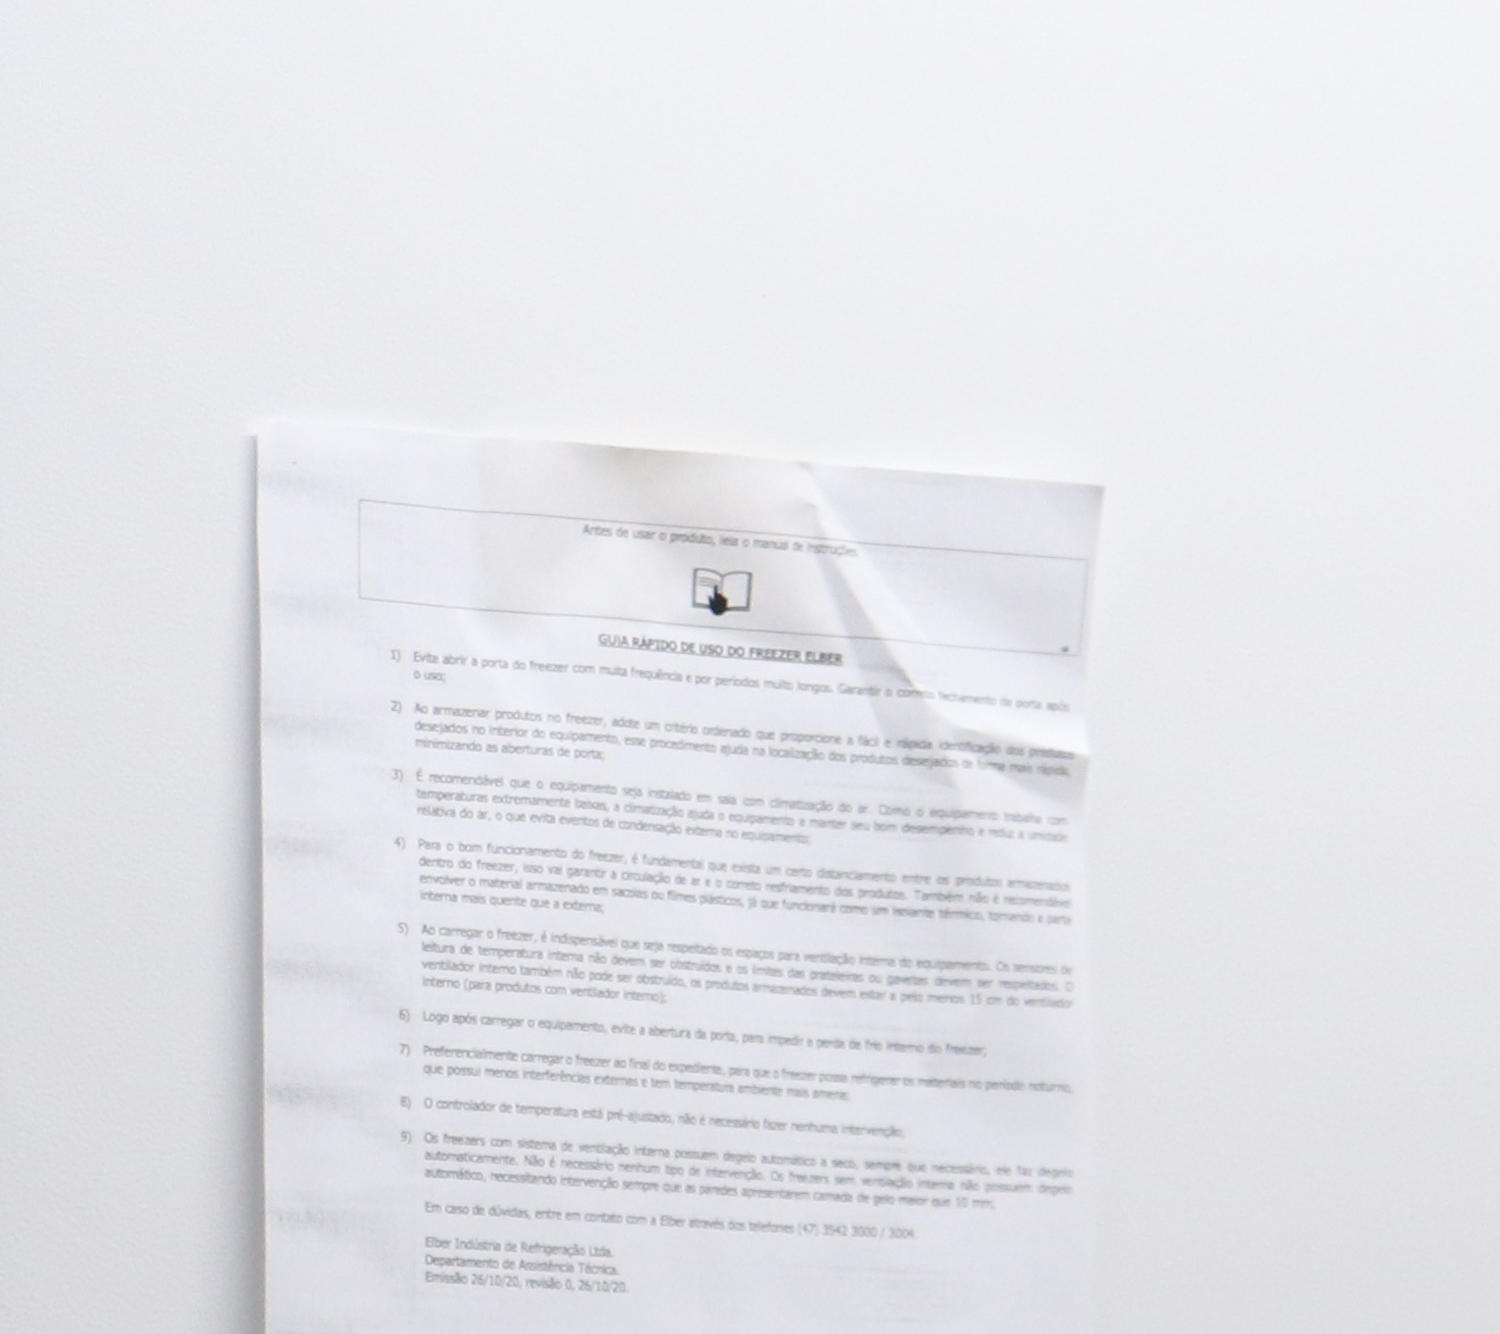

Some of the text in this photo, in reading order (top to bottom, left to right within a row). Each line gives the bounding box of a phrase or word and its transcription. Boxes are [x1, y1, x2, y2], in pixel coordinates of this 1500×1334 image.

[598, 634, 842, 665] GUIA RÁPIDO DE USO DO FREEZER ELBER
[424, 1270, 468, 1284] Emissão
[525, 1276, 561, 1289] revisão
